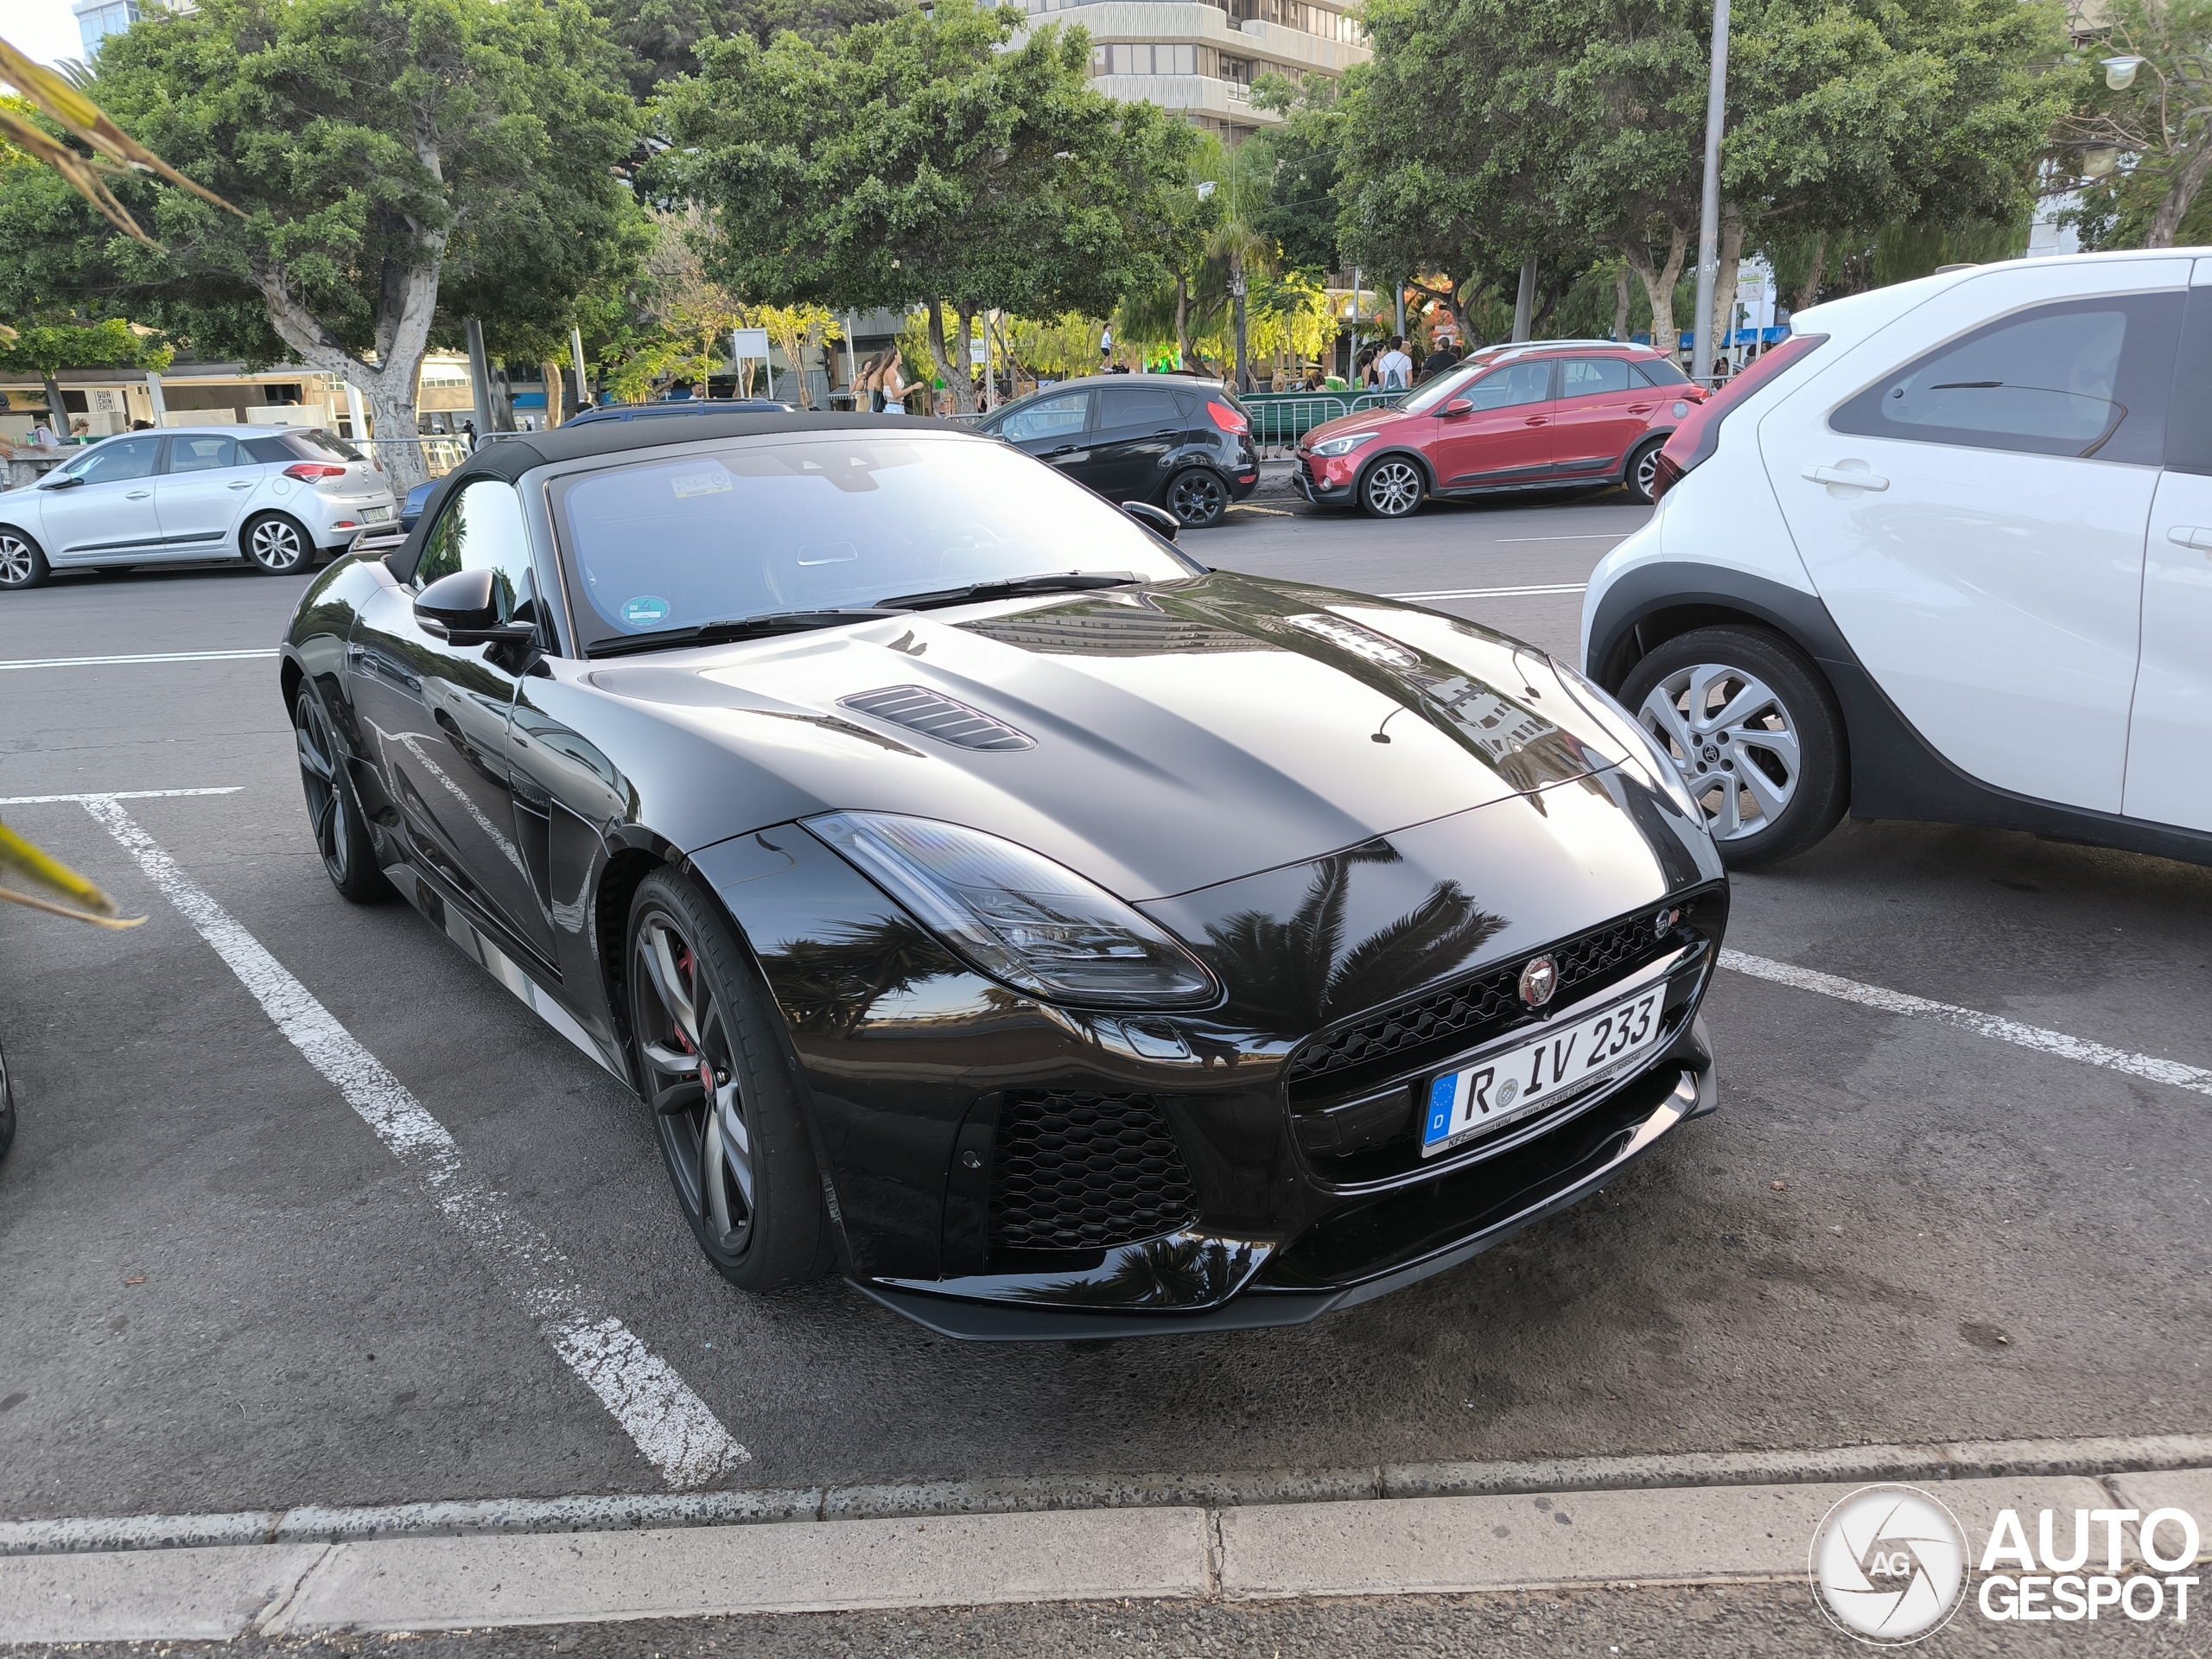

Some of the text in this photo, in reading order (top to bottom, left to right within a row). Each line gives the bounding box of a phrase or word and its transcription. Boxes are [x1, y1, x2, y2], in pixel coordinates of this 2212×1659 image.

[639, 600, 652, 610] 4
[1464, 995, 1656, 1122] R IV 233
[1522, 1082, 1590, 1117] www.KFZ-WILD.com
[1433, 1114, 1444, 1129] D
[1448, 1116, 1512, 1147] KFZ Wild
